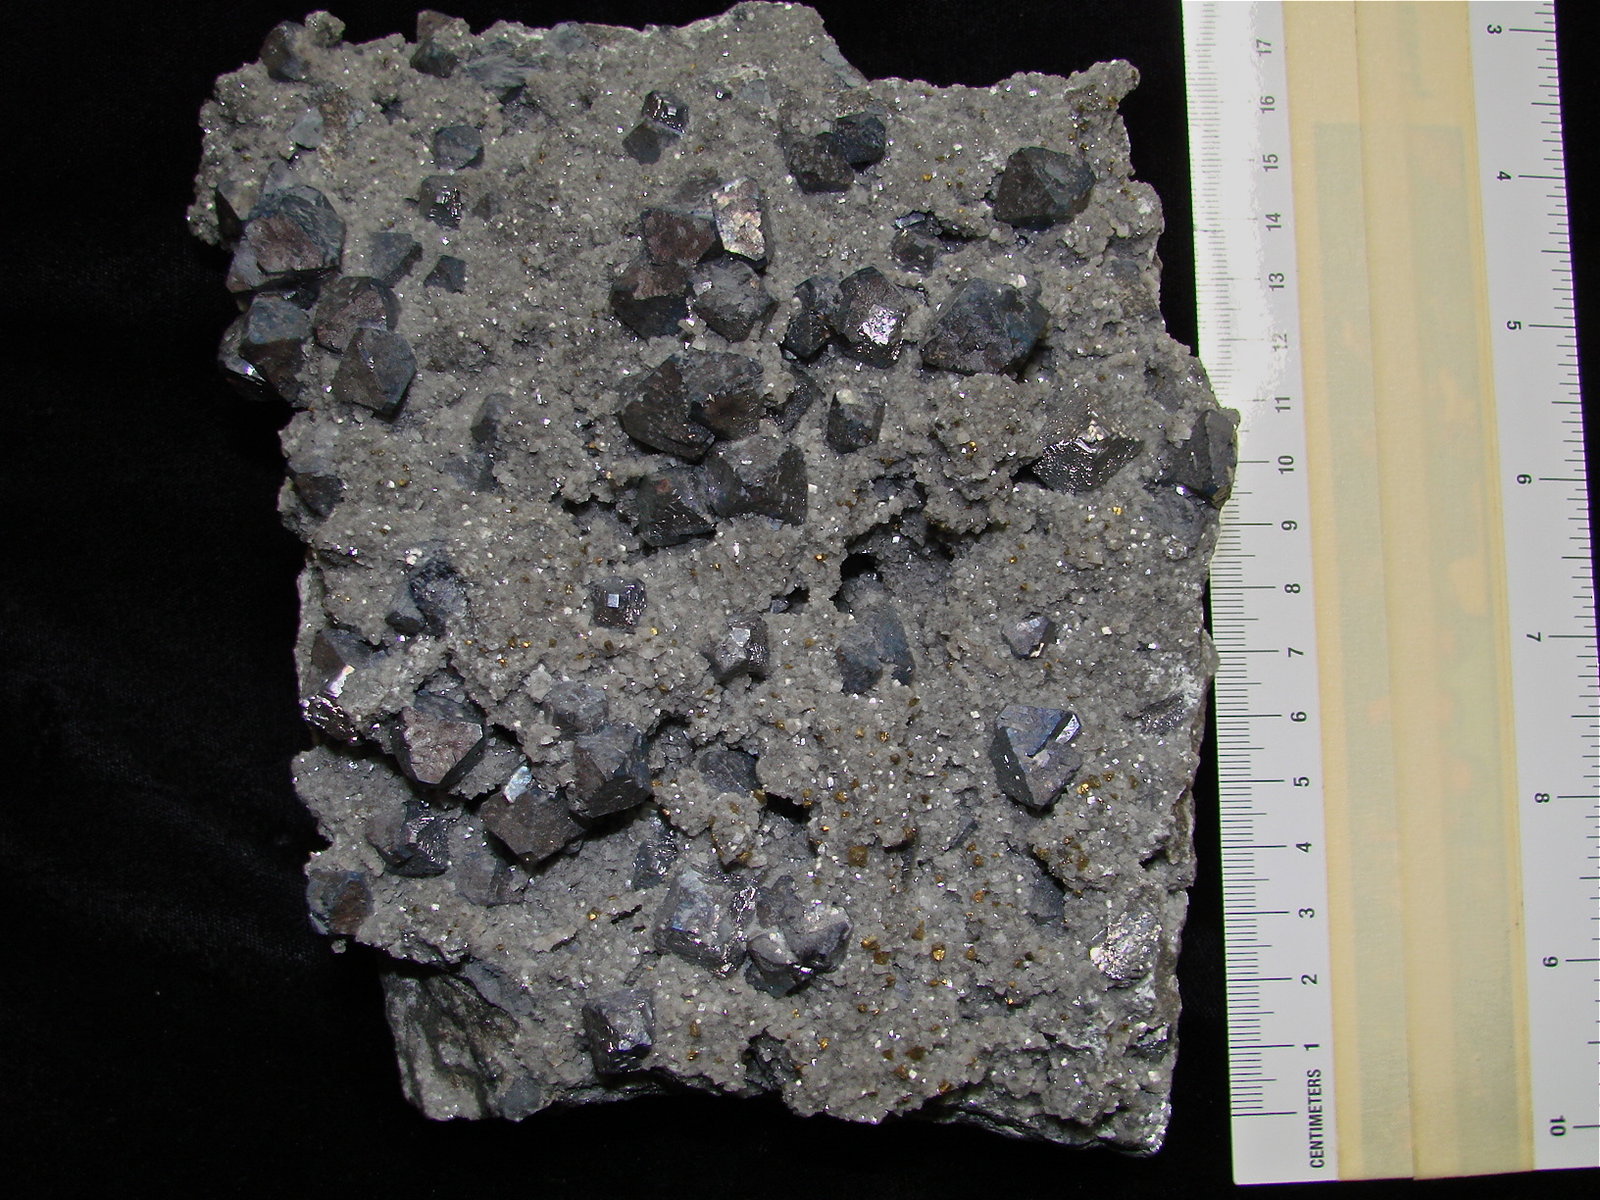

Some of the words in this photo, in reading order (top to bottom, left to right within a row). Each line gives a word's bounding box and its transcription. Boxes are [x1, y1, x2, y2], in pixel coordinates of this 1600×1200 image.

[1486, 24, 1503, 35] 3
[1256, 38, 1272, 56] 17
[1260, 95, 1276, 114] 16
[1263, 153, 1279, 173] 15
[1496, 170, 1512, 181] 4
[1265, 212, 1282, 232] 14
[1268, 271, 1285, 292] 13
[1506, 320, 1522, 331] 5
[1275, 395, 1291, 412] 11
[1277, 454, 1295, 475] 10
[1516, 473, 1533, 485] 6
[1281, 519, 1298, 531] 9
[1284, 582, 1301, 595] 8
[1525, 631, 1542, 643] 7
[1287, 646, 1304, 658] 7
[1290, 711, 1307, 723] 6
[1293, 776, 1310, 788] 5
[1534, 792, 1550, 804] 8
[1296, 841, 1312, 854] 4
[1299, 907, 1316, 919] 3
[1543, 956, 1559, 968] 9
[1301, 973, 1318, 985] 2
[1303, 1043, 1320, 1051] 1
[1309, 1068, 1325, 1169] CENTIMETERS
[1550, 1114, 1567, 1136] 10
